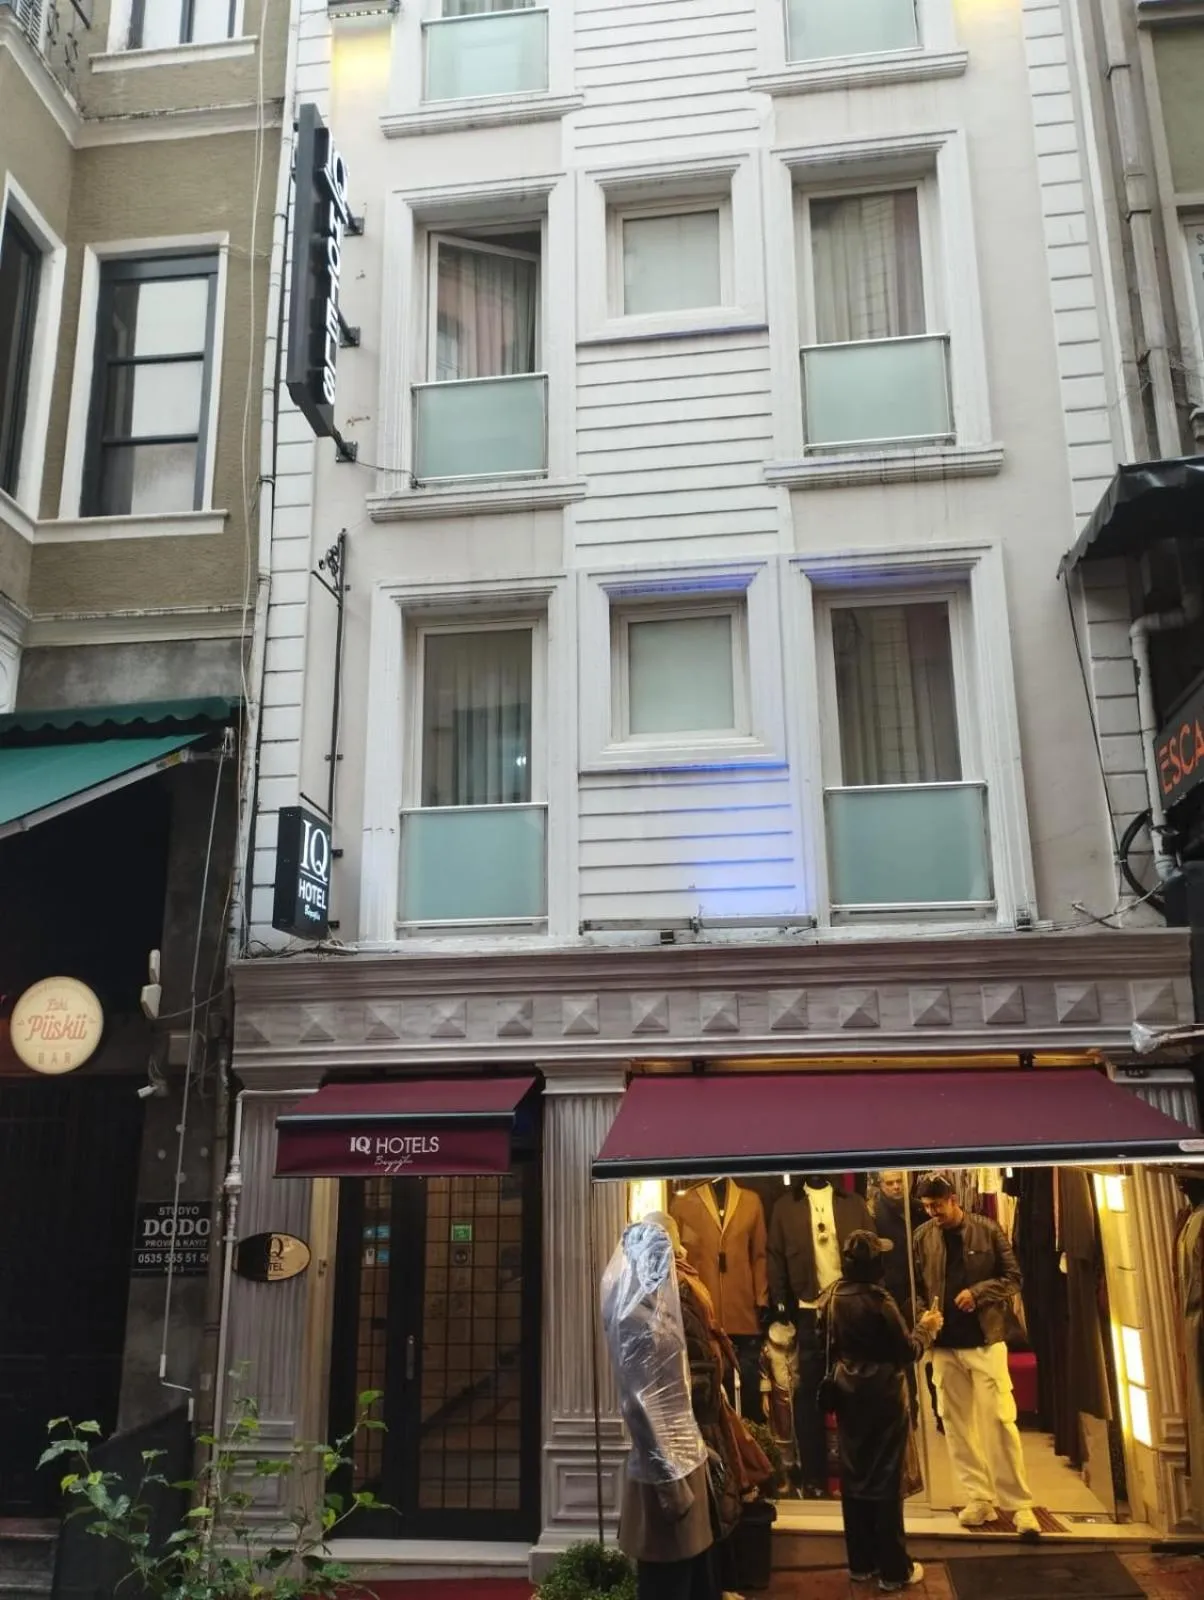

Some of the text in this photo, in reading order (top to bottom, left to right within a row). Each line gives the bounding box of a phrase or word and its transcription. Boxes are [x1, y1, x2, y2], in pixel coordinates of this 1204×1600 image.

[300, 820, 329, 882] IQ
[298, 878, 327, 910] HOTEL
[24, 1013, 88, 1041] Püskü
[38, 1052, 71, 1065] BAR
[350, 1136, 440, 1154] IQ HOTELS
[142, 1218, 211, 1236] DODO
[138, 1253, 163, 1264] 0535
